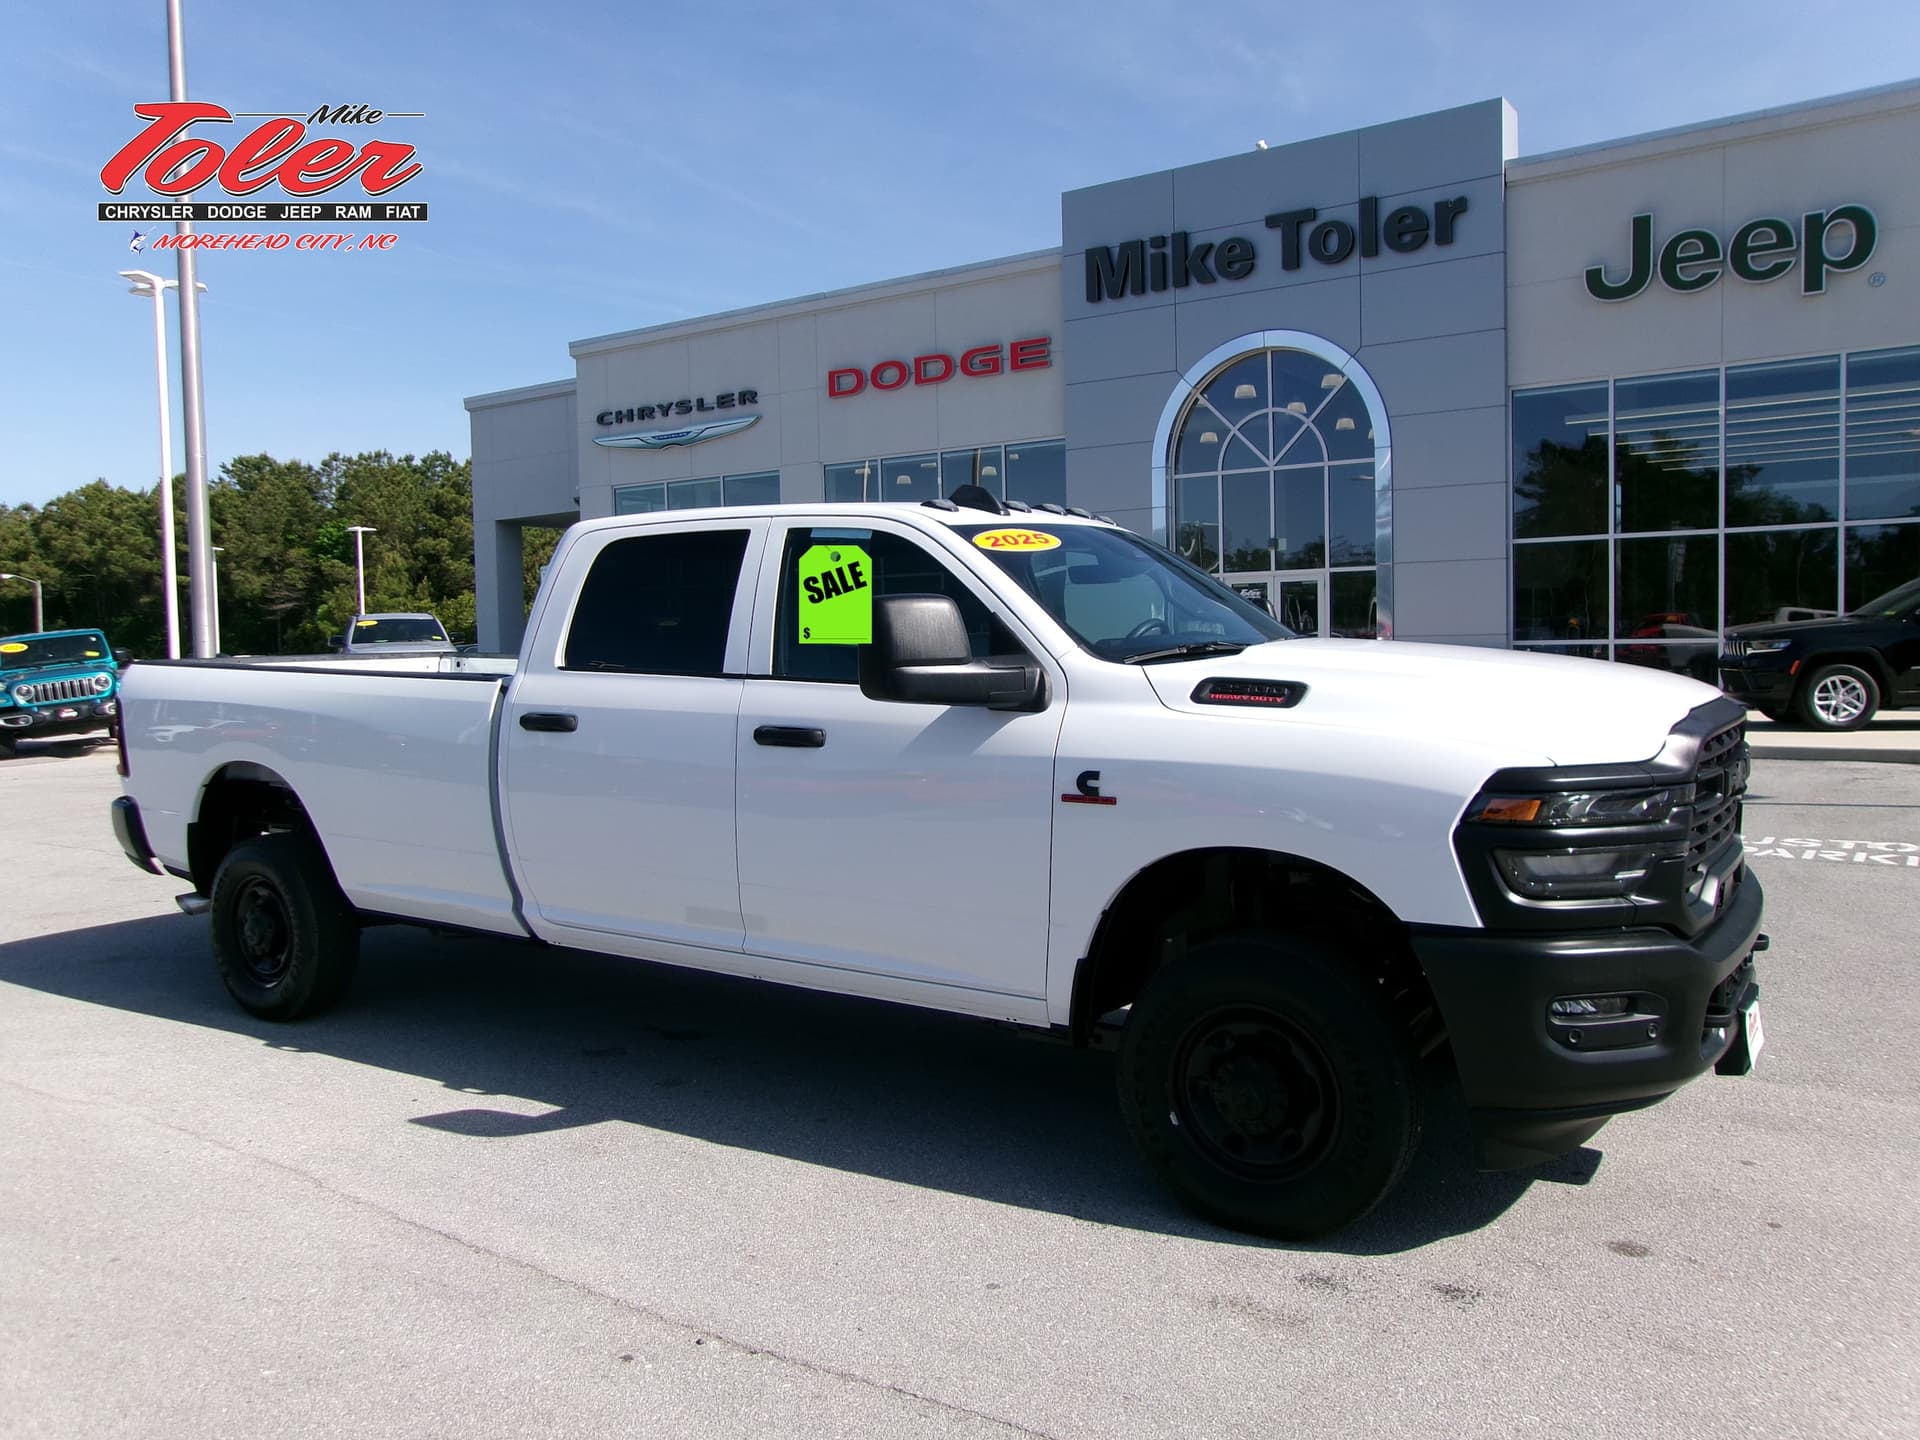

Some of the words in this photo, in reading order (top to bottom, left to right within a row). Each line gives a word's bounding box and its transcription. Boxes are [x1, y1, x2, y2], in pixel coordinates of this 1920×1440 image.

[1085, 231, 1256, 303] Mike
[1265, 195, 1468, 271] Toler
[1584, 203, 1878, 302] Jeep
[828, 336, 1053, 399] DODGE
[596, 389, 759, 426] CHRYSLER
[985, 533, 1050, 548] 2025
